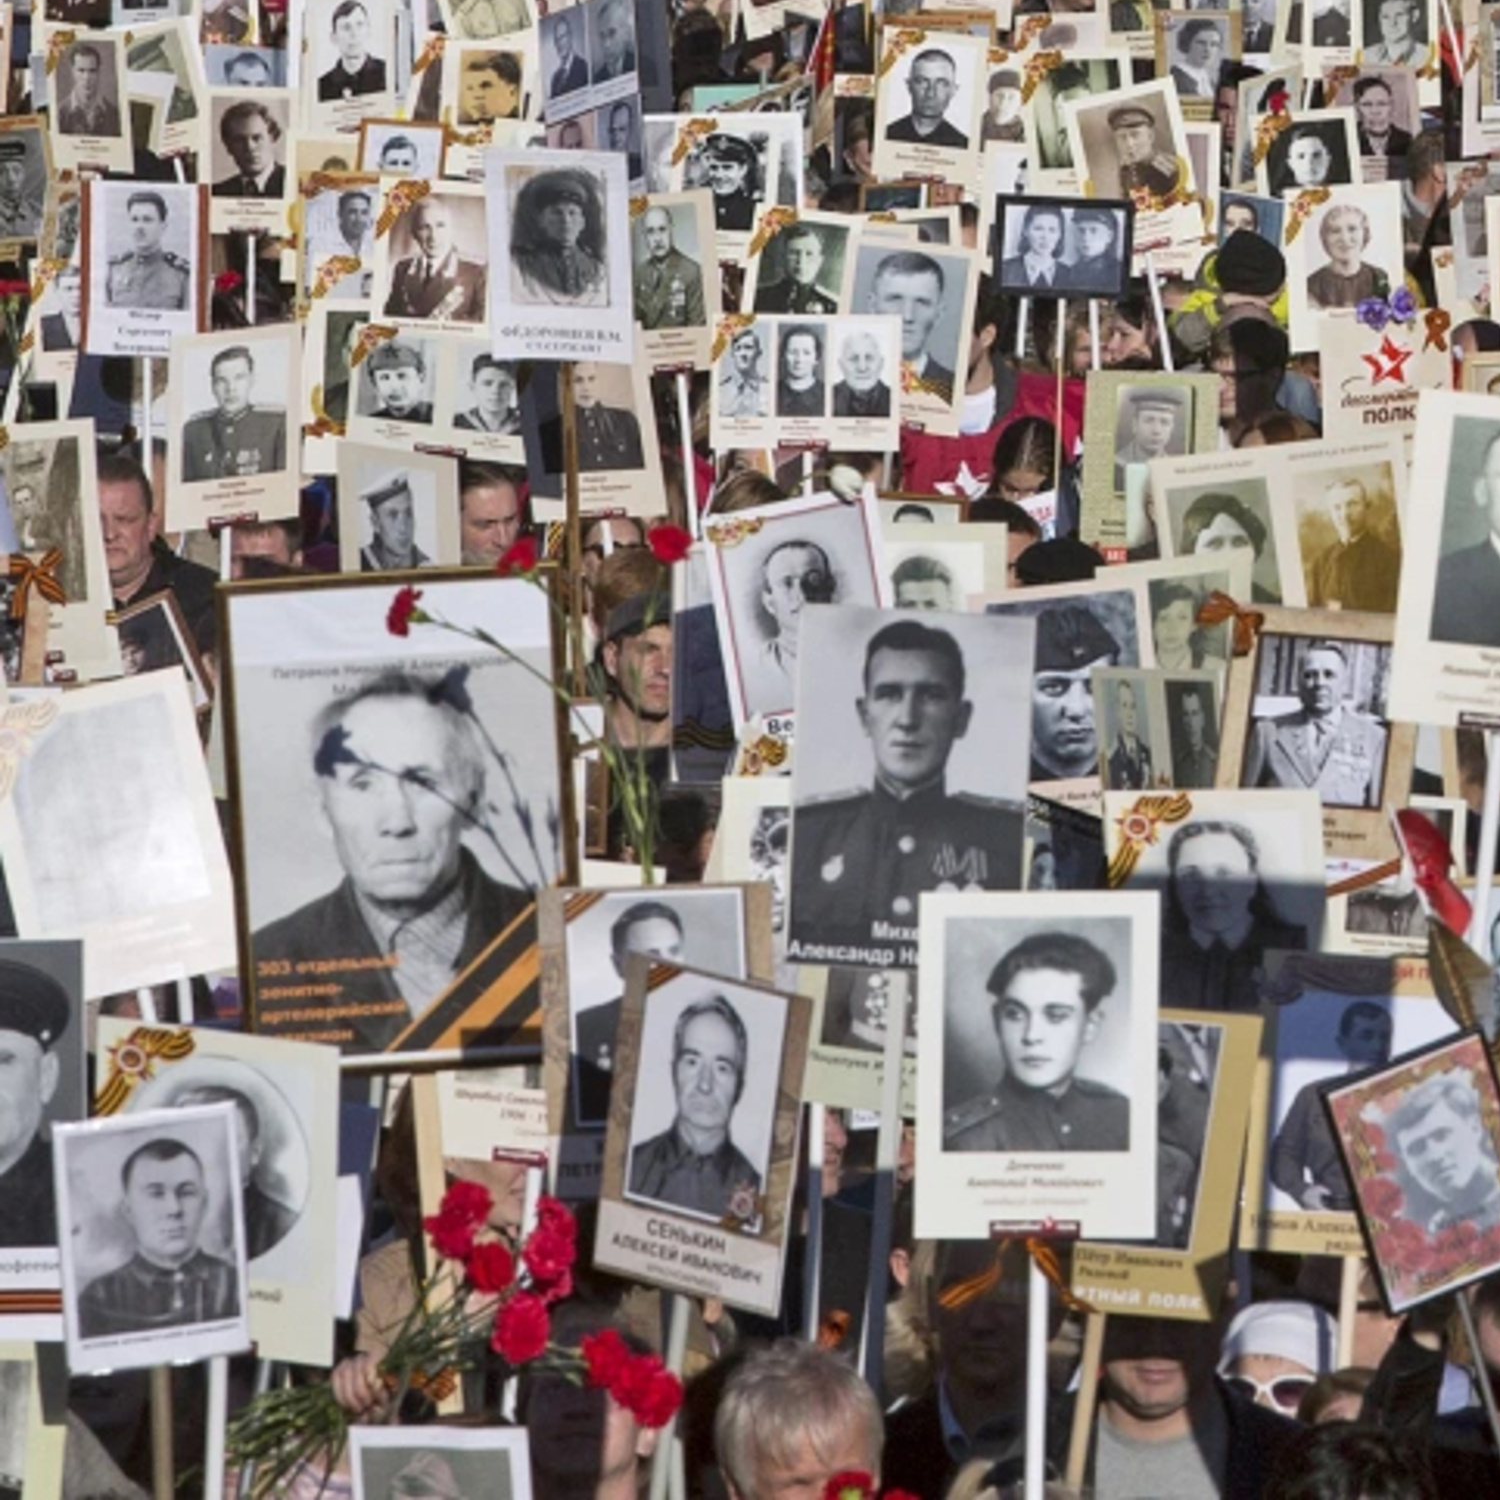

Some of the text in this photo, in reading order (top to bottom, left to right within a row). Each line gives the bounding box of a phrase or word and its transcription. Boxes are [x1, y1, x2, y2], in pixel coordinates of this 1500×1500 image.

[790, 940, 894, 963] Александр
[646, 1218, 727, 1254] СЕНЬКИН
[611, 1232, 763, 1285] АЛЕКСЕЙ ИВАНОВИЧ
